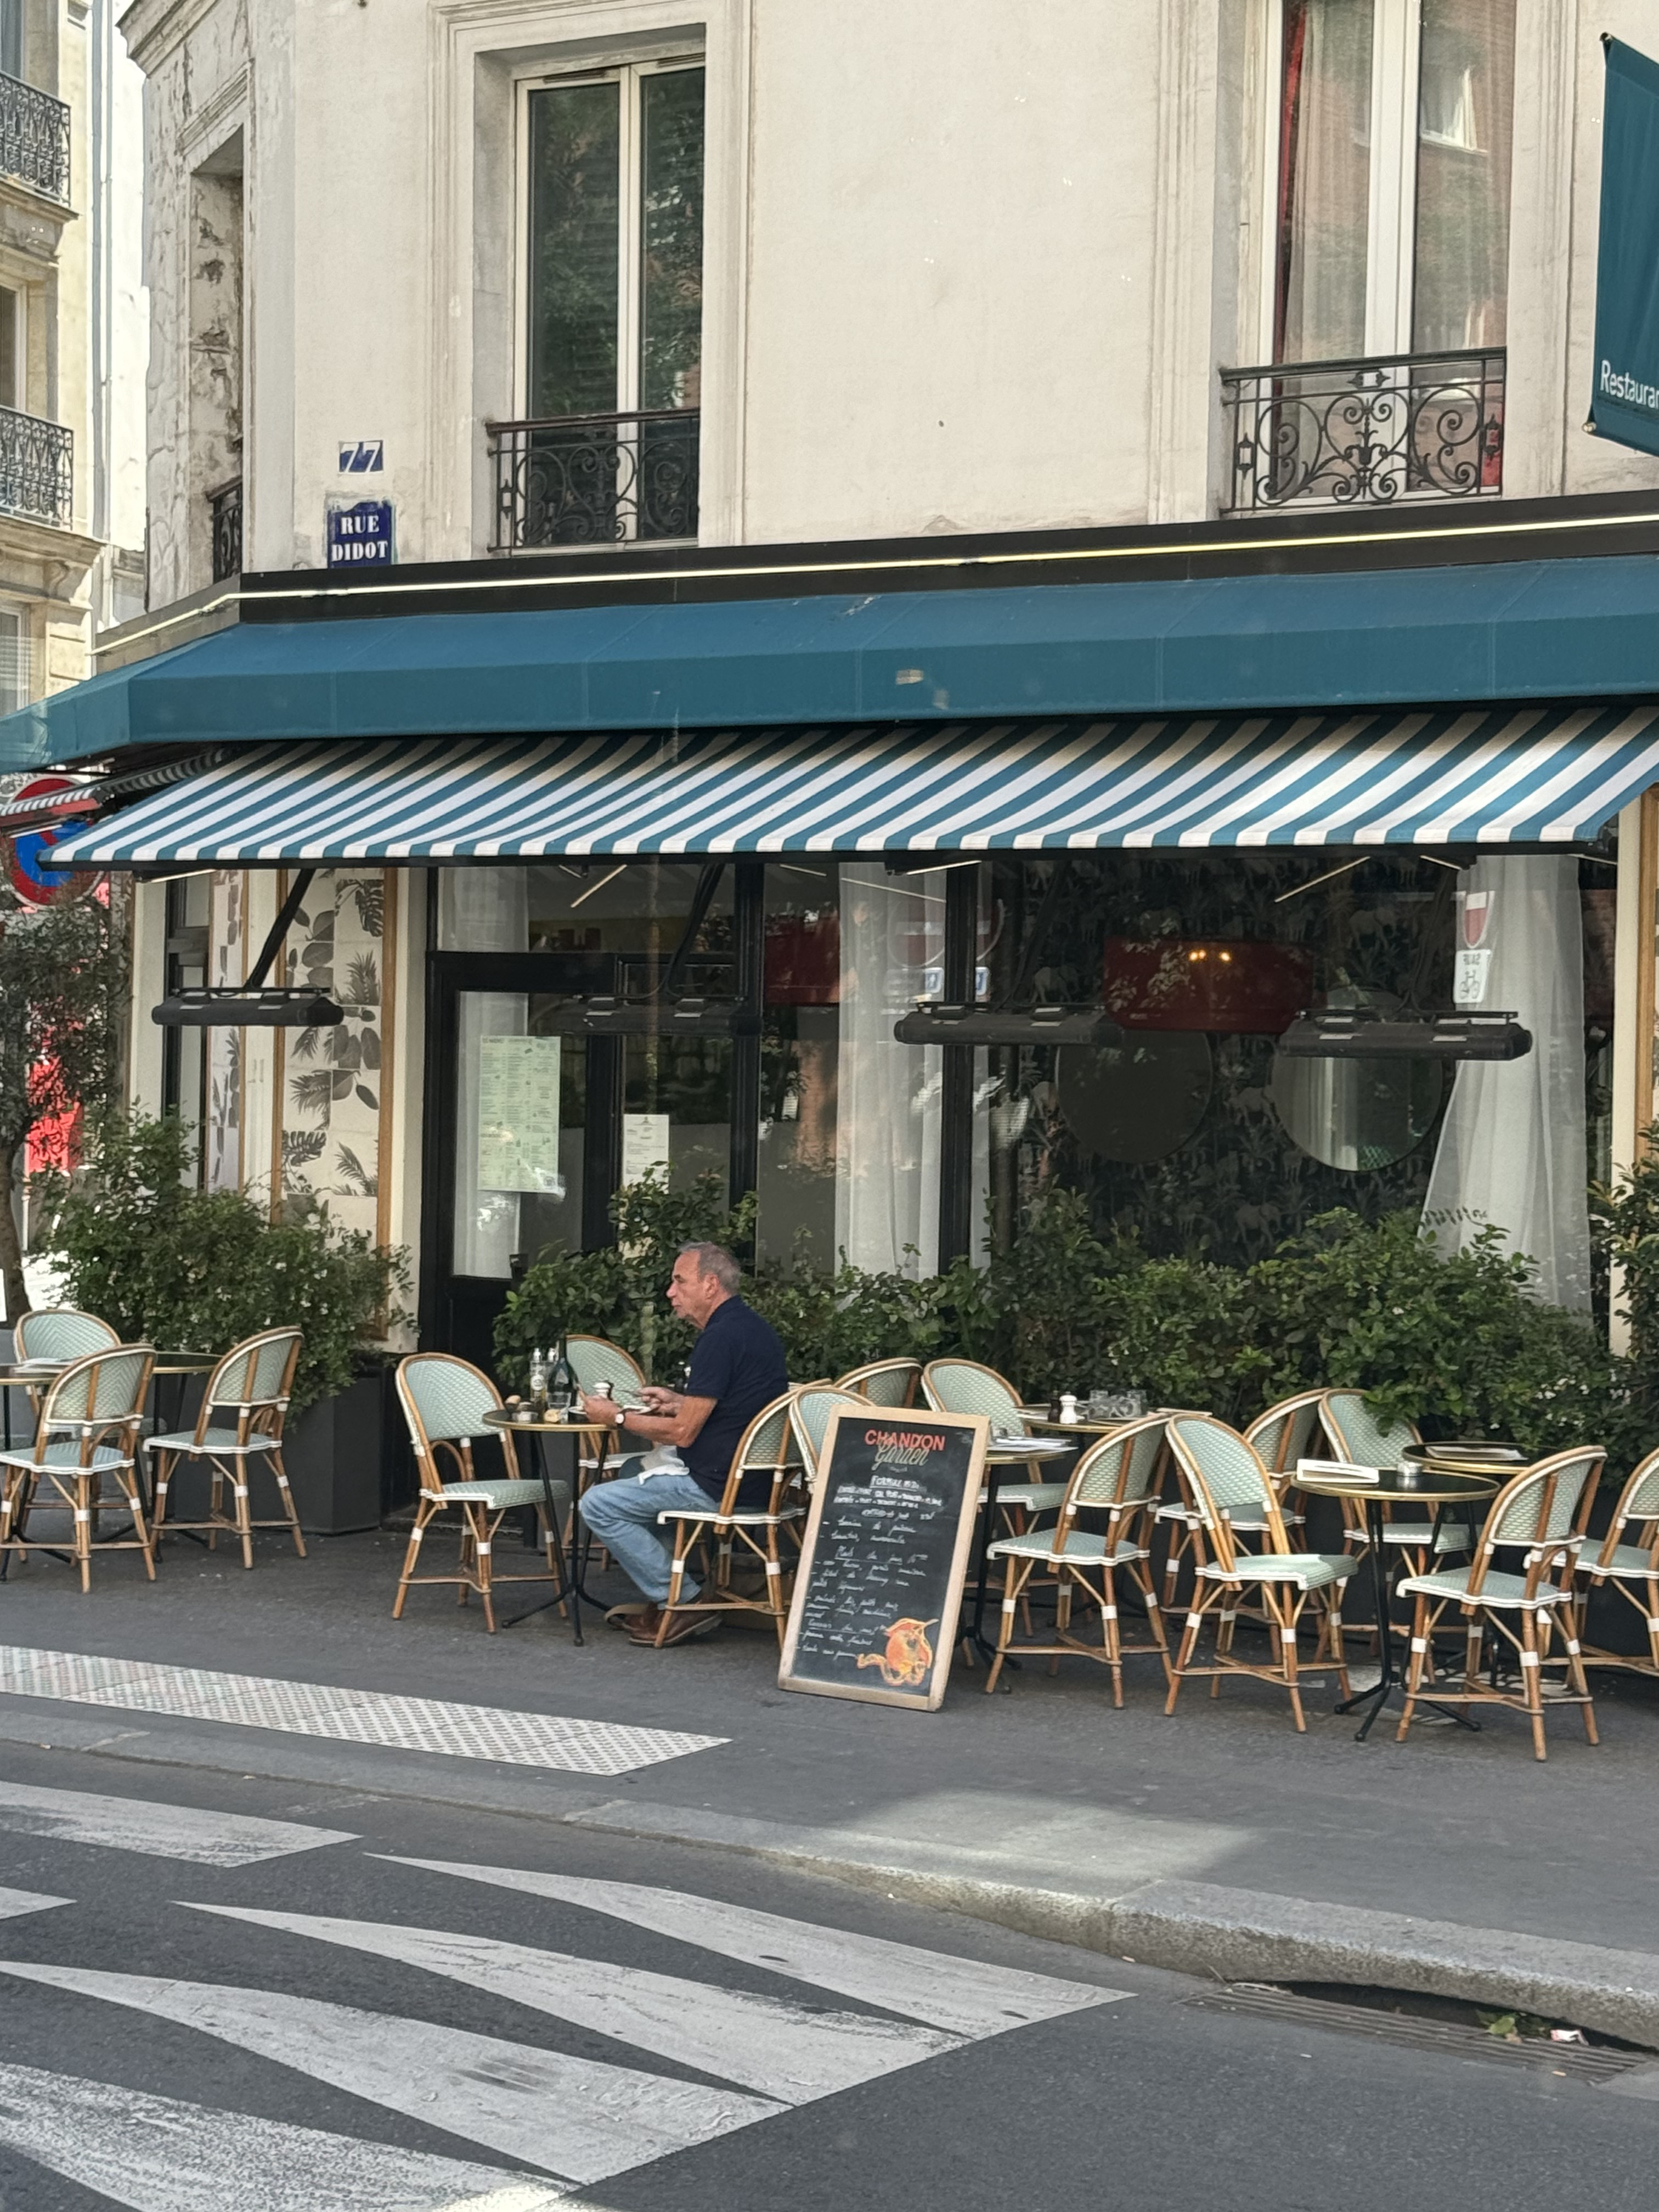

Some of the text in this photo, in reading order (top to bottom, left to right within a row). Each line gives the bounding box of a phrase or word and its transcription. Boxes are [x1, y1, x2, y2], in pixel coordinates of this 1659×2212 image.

[340, 441, 381, 472] 77
[341, 515, 379, 534] RUE
[331, 541, 388, 562] DIDOT
[865, 1429, 945, 1451] CHANDON
[871, 1434, 929, 1470] Garden
